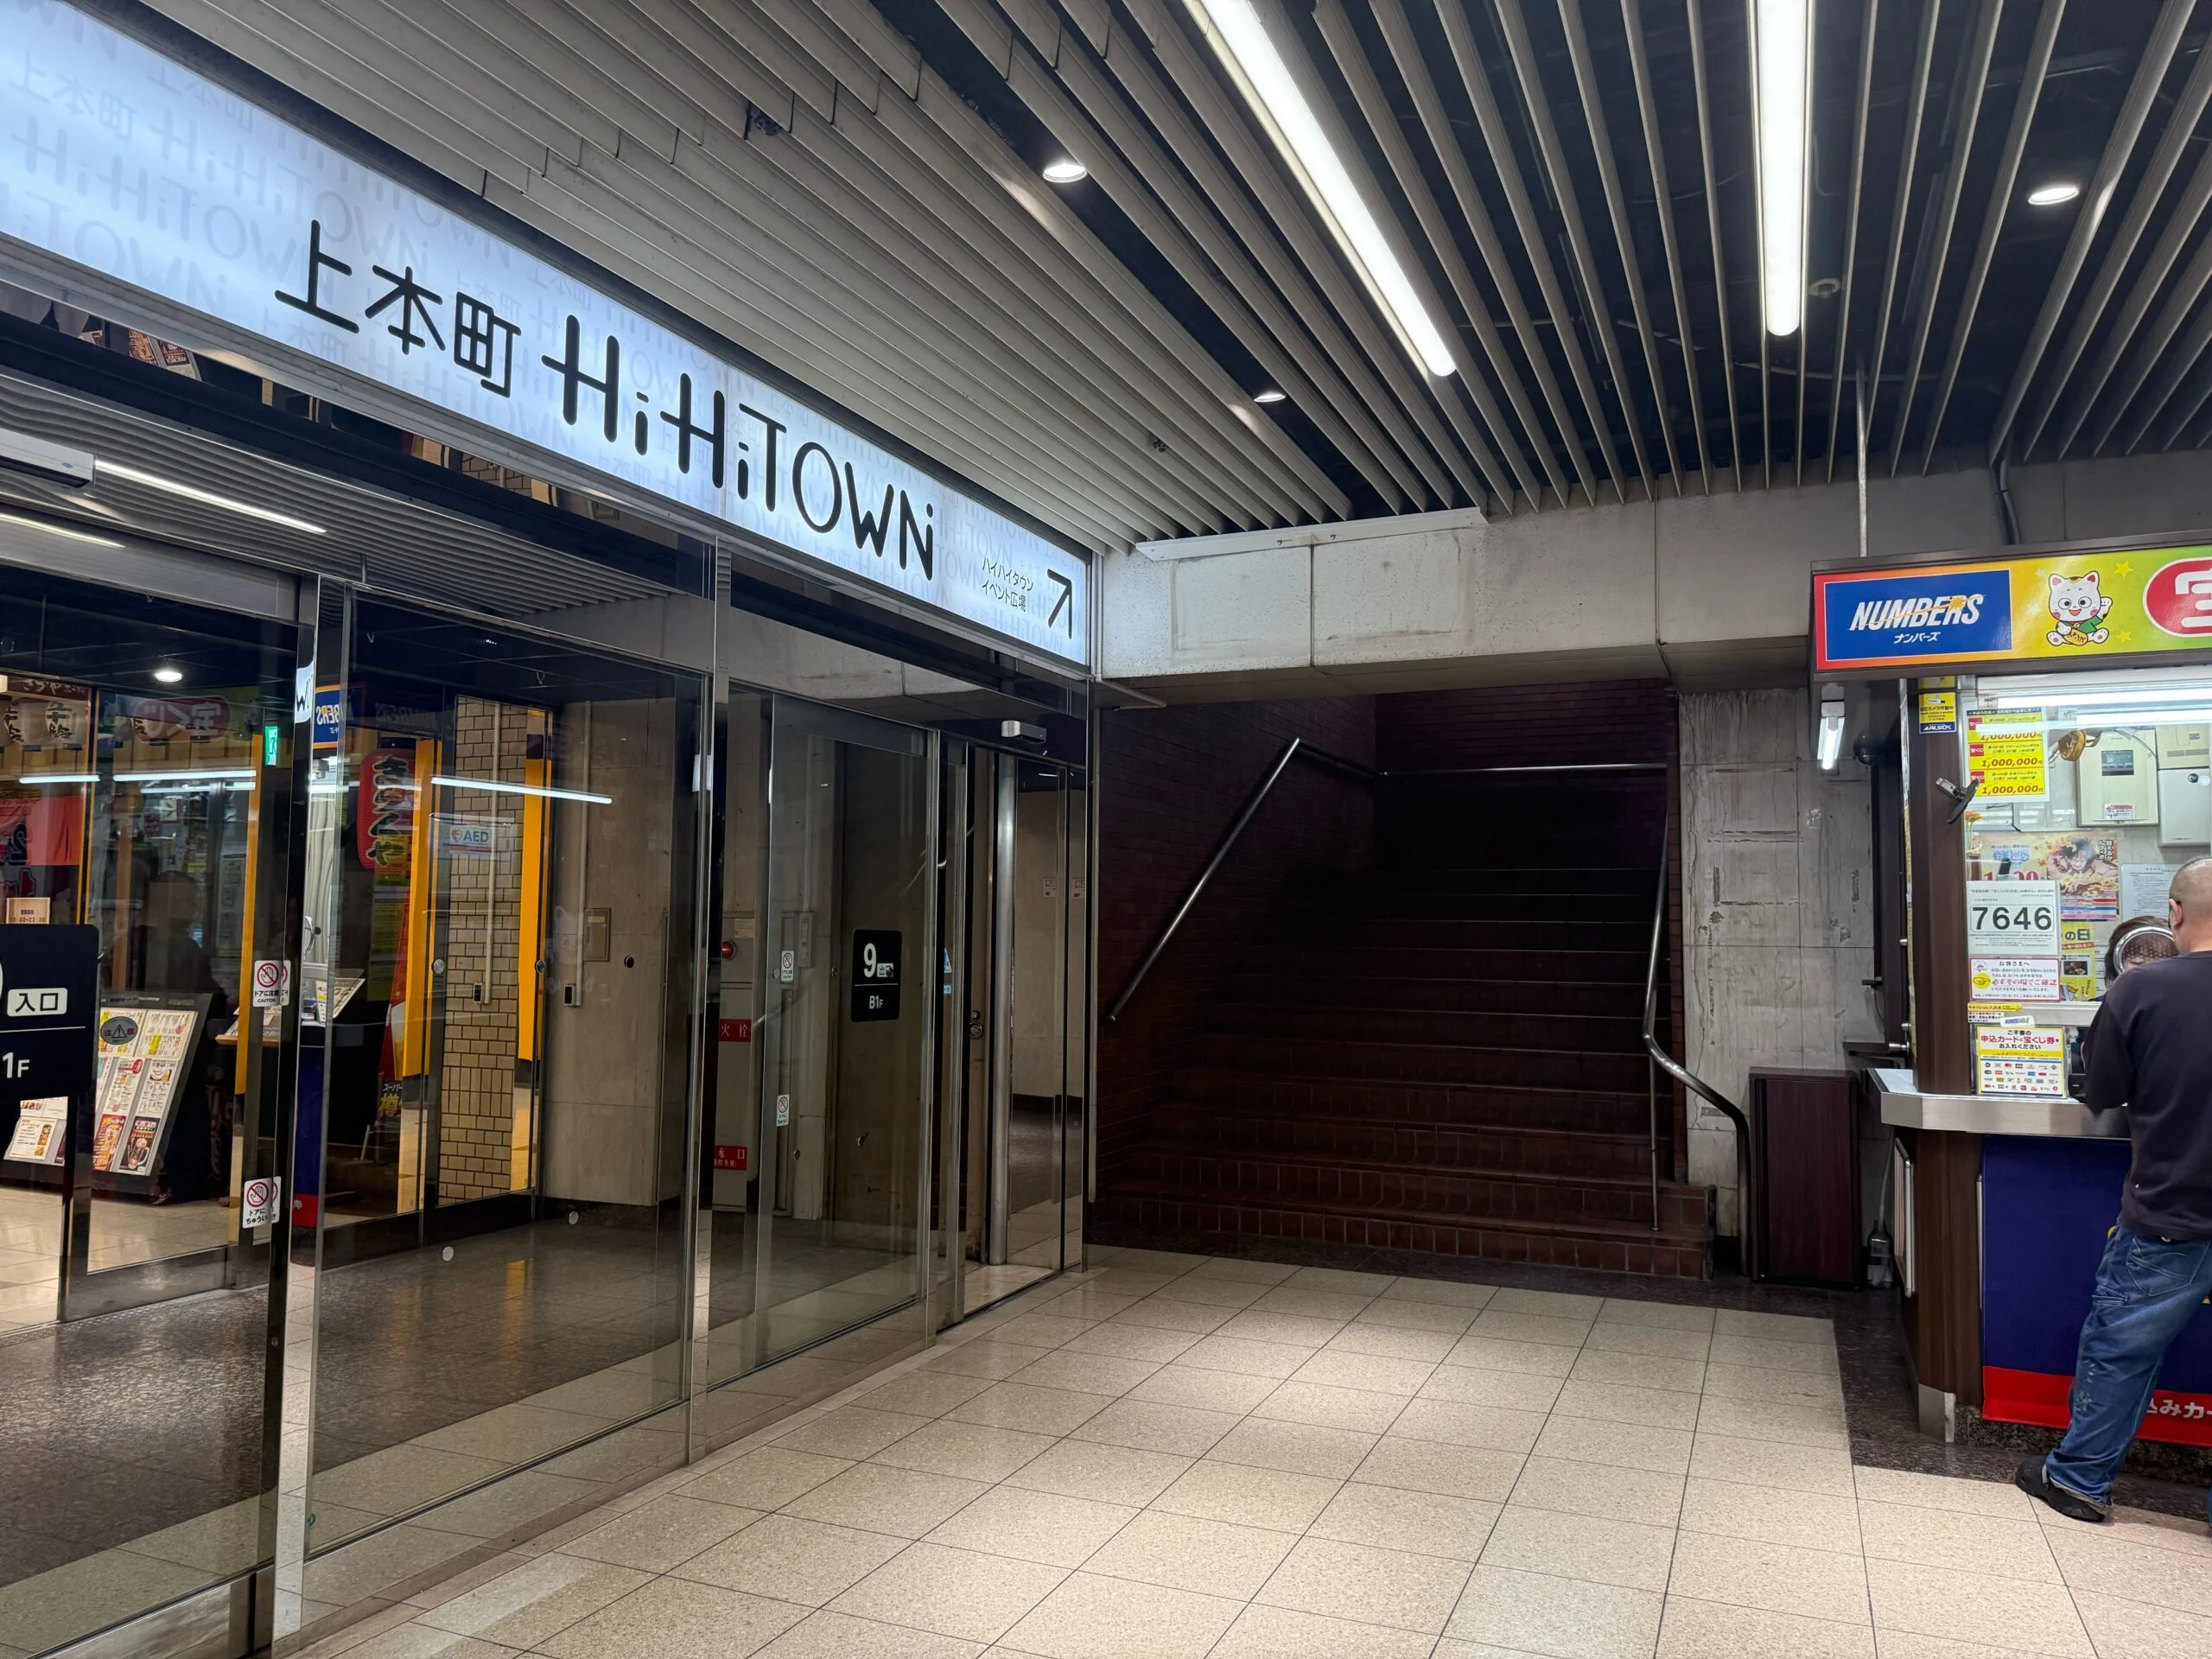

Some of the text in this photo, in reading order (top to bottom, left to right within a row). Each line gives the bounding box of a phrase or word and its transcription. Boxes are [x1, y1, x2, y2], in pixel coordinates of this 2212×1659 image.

[274, 219, 522, 398] 上本町
[982, 557, 1034, 591] ハイハイタウン
[982, 580, 1027, 613] イベント広場
[1849, 594, 1985, 632] NUMBERS
[1893, 631, 1941, 644] ナンバーズ
[463, 830, 489, 842] AED
[1972, 906, 2052, 931] 7646
[2062, 929, 2090, 940] の日
[864, 943, 877, 978] 9
[15, 992, 60, 1013] 入口
[868, 995, 884, 1009] B1F
[2, 1052, 30, 1080] 1F
[2146, 1397, 2212, 1419] みカ
